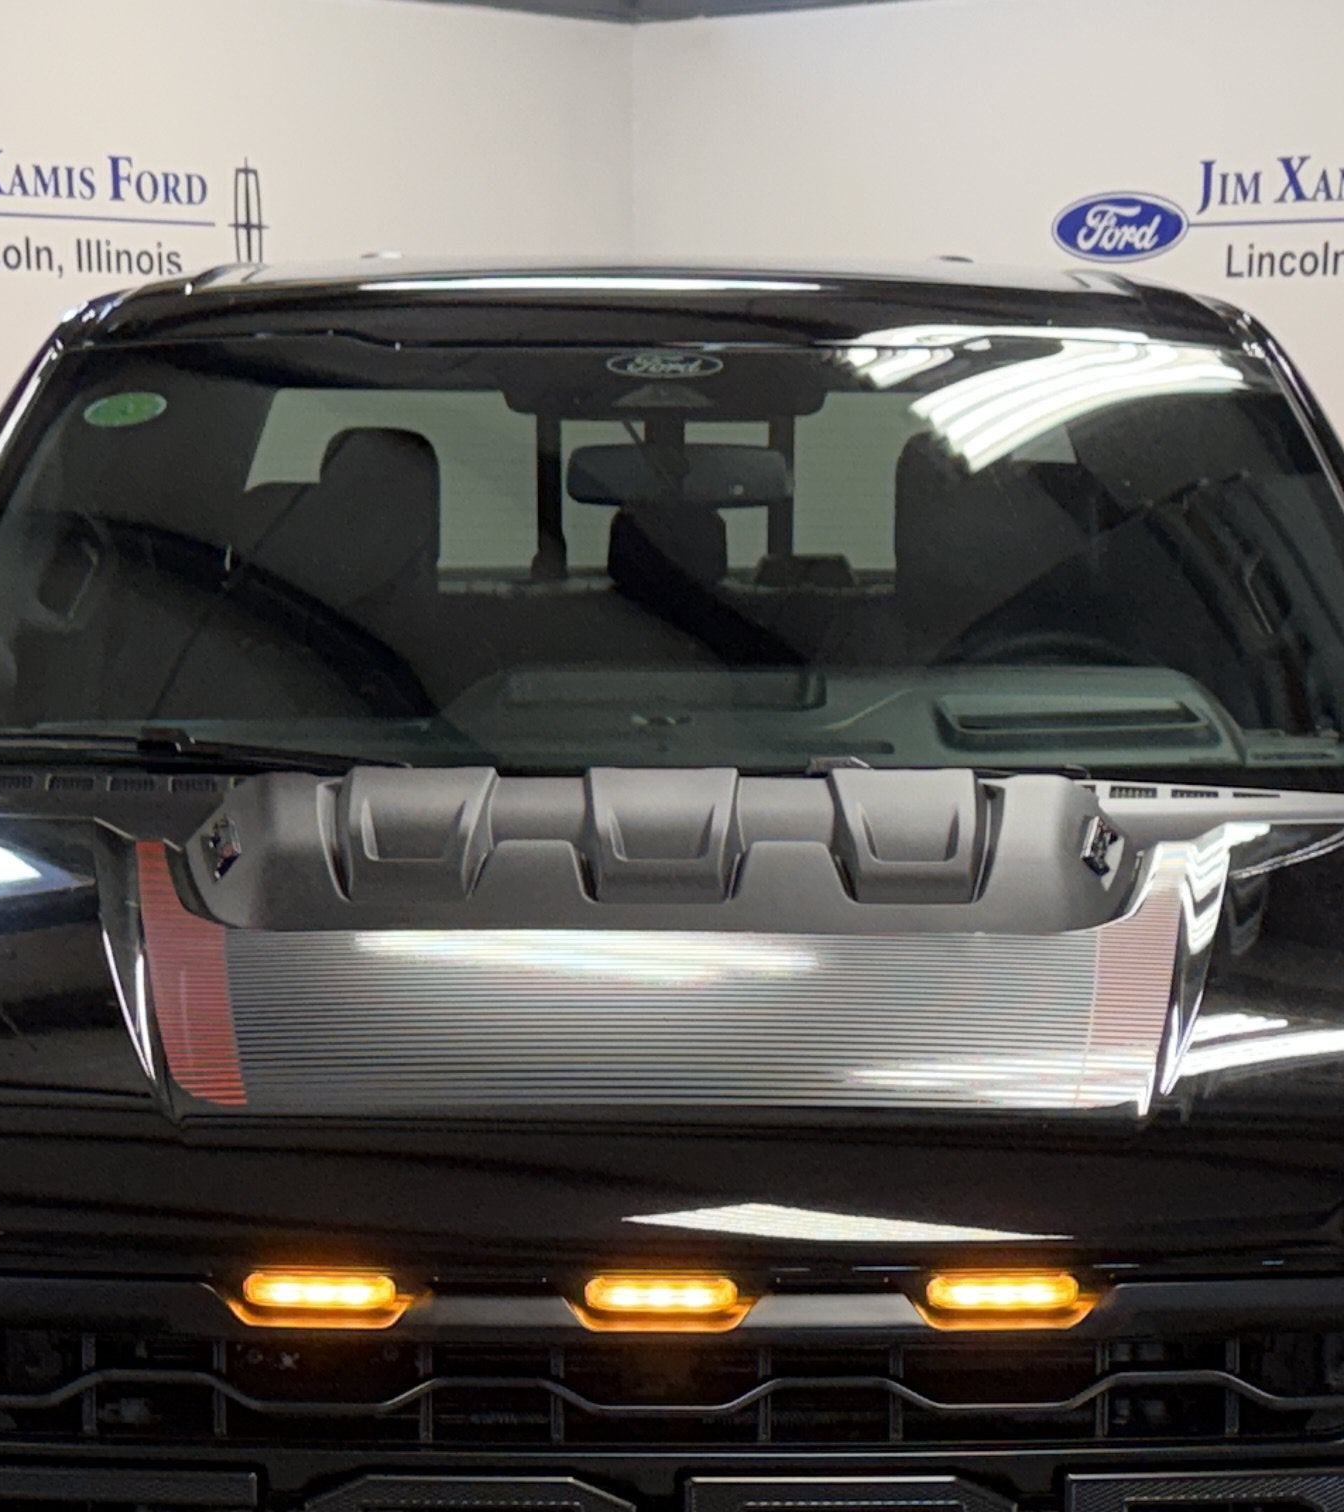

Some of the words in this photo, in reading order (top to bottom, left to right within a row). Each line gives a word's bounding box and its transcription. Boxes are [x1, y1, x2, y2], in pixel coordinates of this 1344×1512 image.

[108, 155, 208, 205] FORD
[1196, 160, 1261, 214] JIM
[1076, 204, 1160, 252] Ford
[76, 238, 183, 276] Illinois
